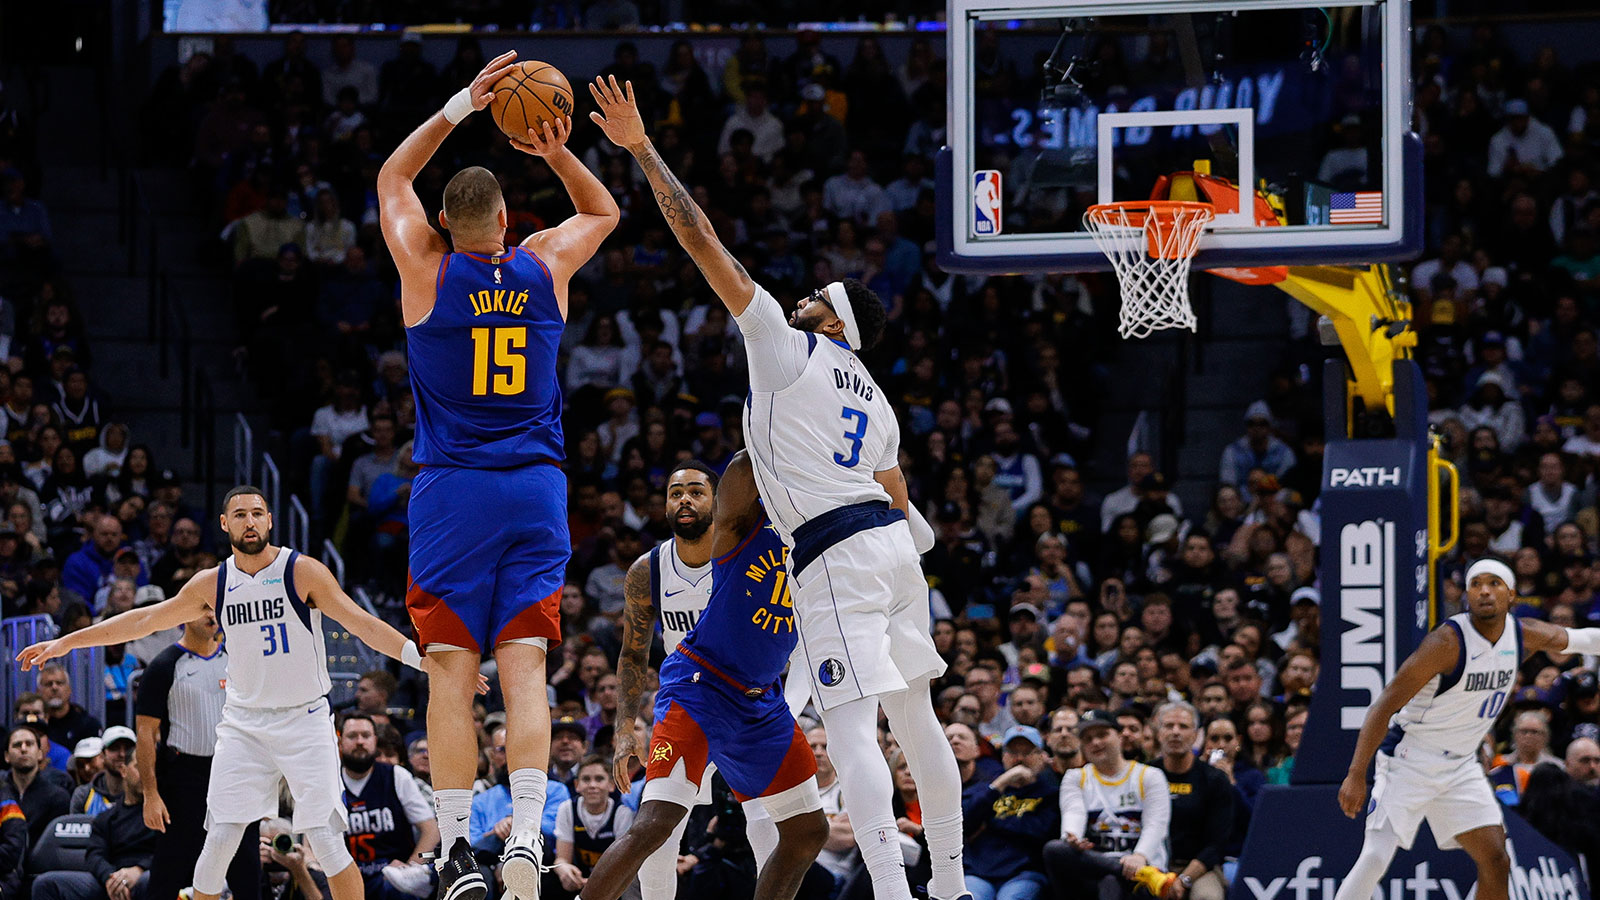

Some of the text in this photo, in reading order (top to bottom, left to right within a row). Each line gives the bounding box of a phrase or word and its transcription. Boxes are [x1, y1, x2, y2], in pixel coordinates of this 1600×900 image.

[469, 289, 529, 316] JOKIĆ
[471, 326, 527, 396] 15
[833, 405, 868, 468] 3
[1330, 466, 1400, 487] PATH
[226, 597, 284, 626] DALLAS
[752, 607, 794, 634] CITY
[1340, 520, 1384, 730] UMB
[260, 622, 290, 656] 31
[1464, 669, 1514, 691] DALLAS
[1477, 691, 1506, 718] 10
